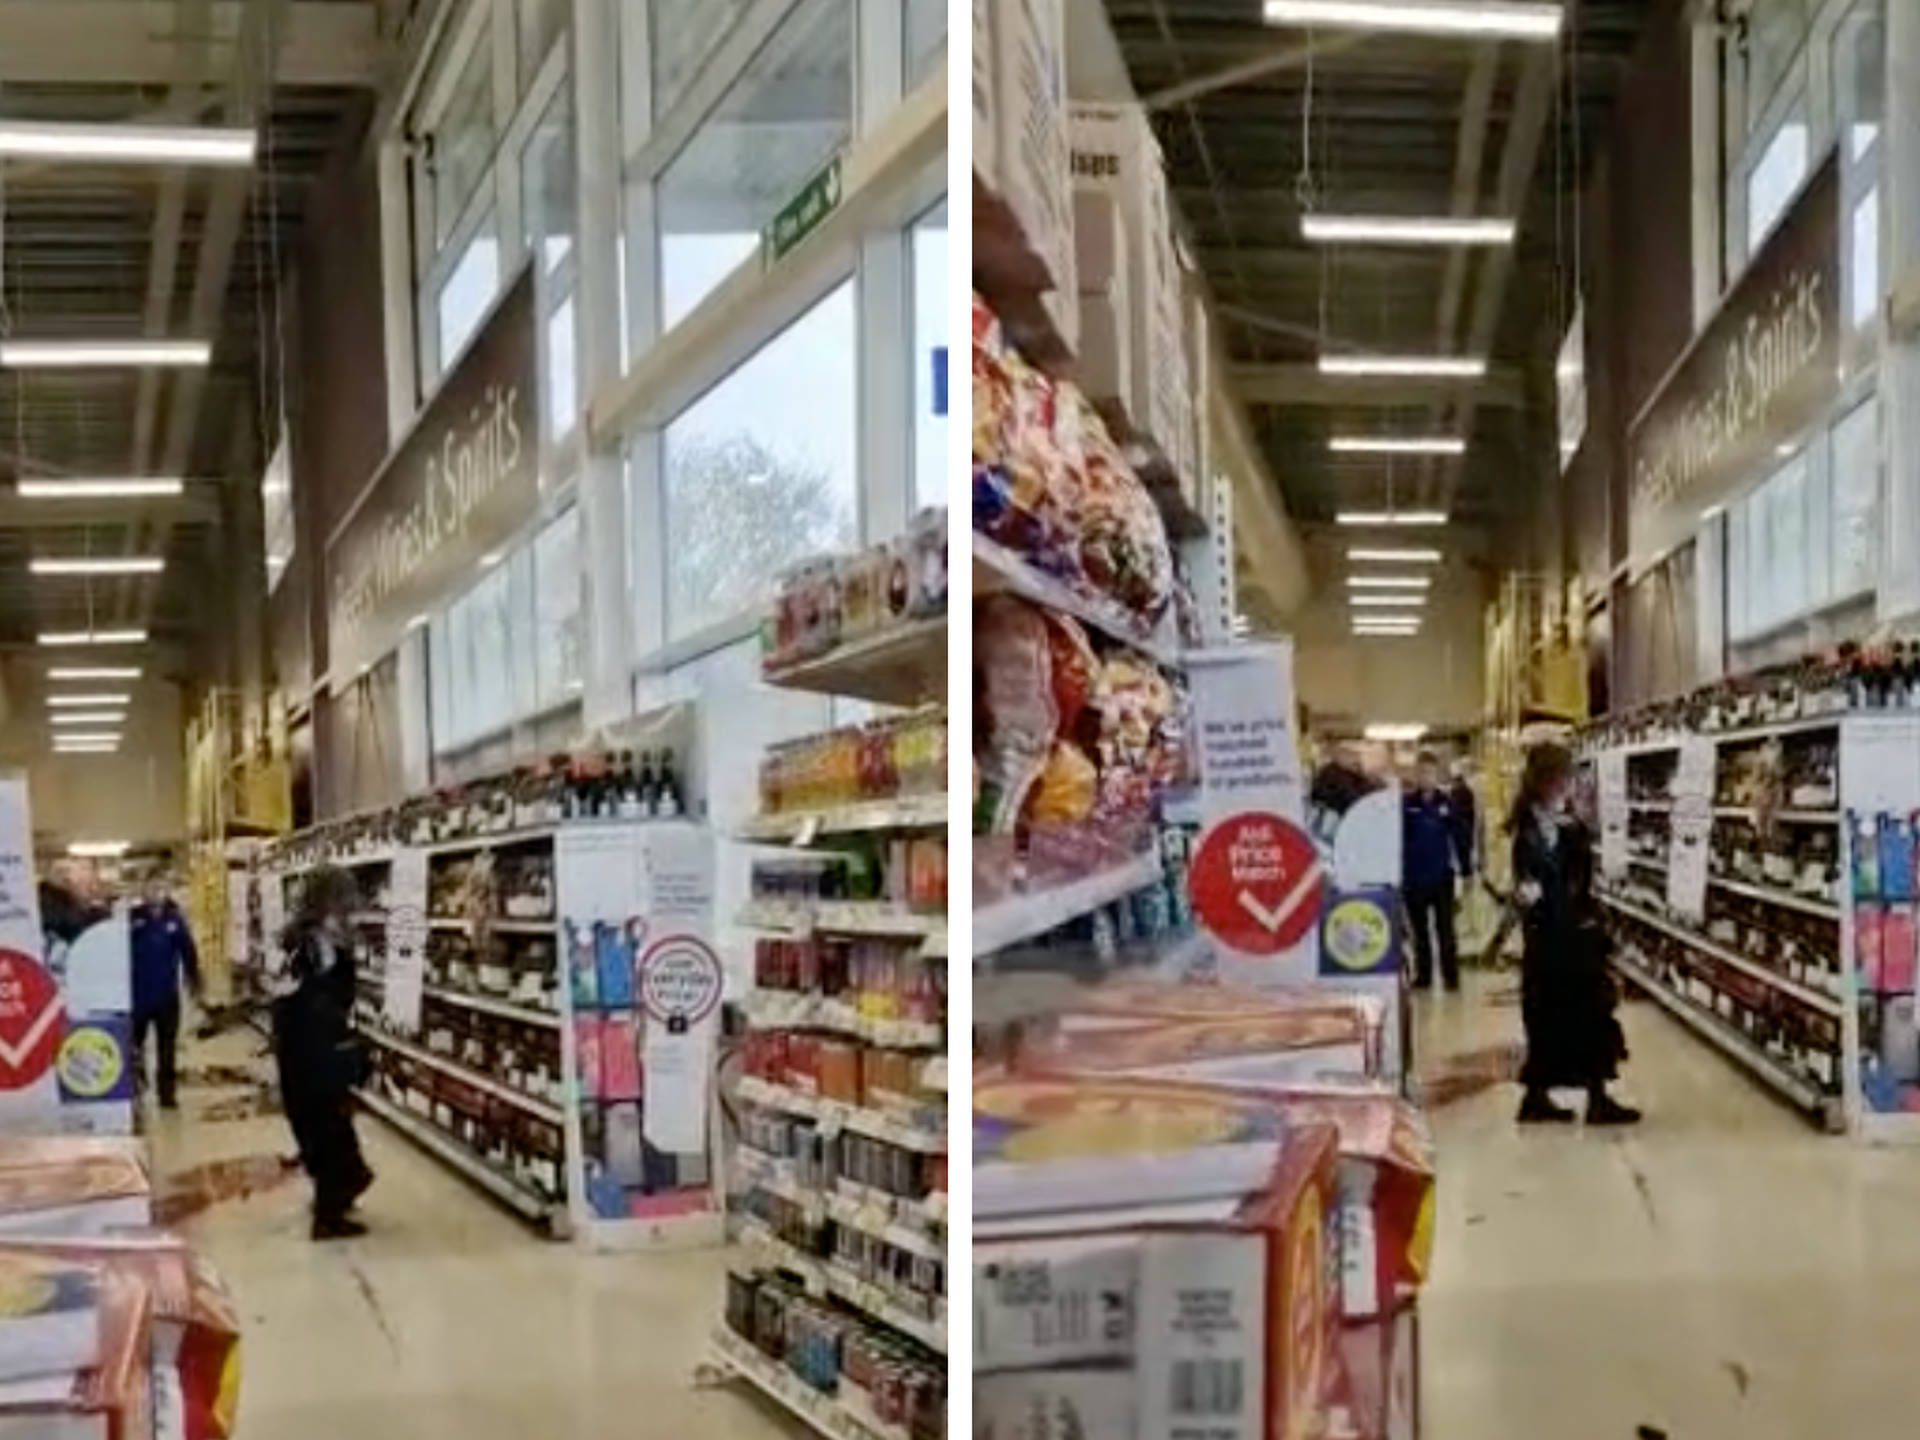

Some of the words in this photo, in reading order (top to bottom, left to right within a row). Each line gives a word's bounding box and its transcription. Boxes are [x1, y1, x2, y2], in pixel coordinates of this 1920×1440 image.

[1726, 337, 1742, 442] &
[1744, 270, 1822, 430] Spirits
[425, 456, 441, 552] &
[443, 385, 522, 542] Spirits
